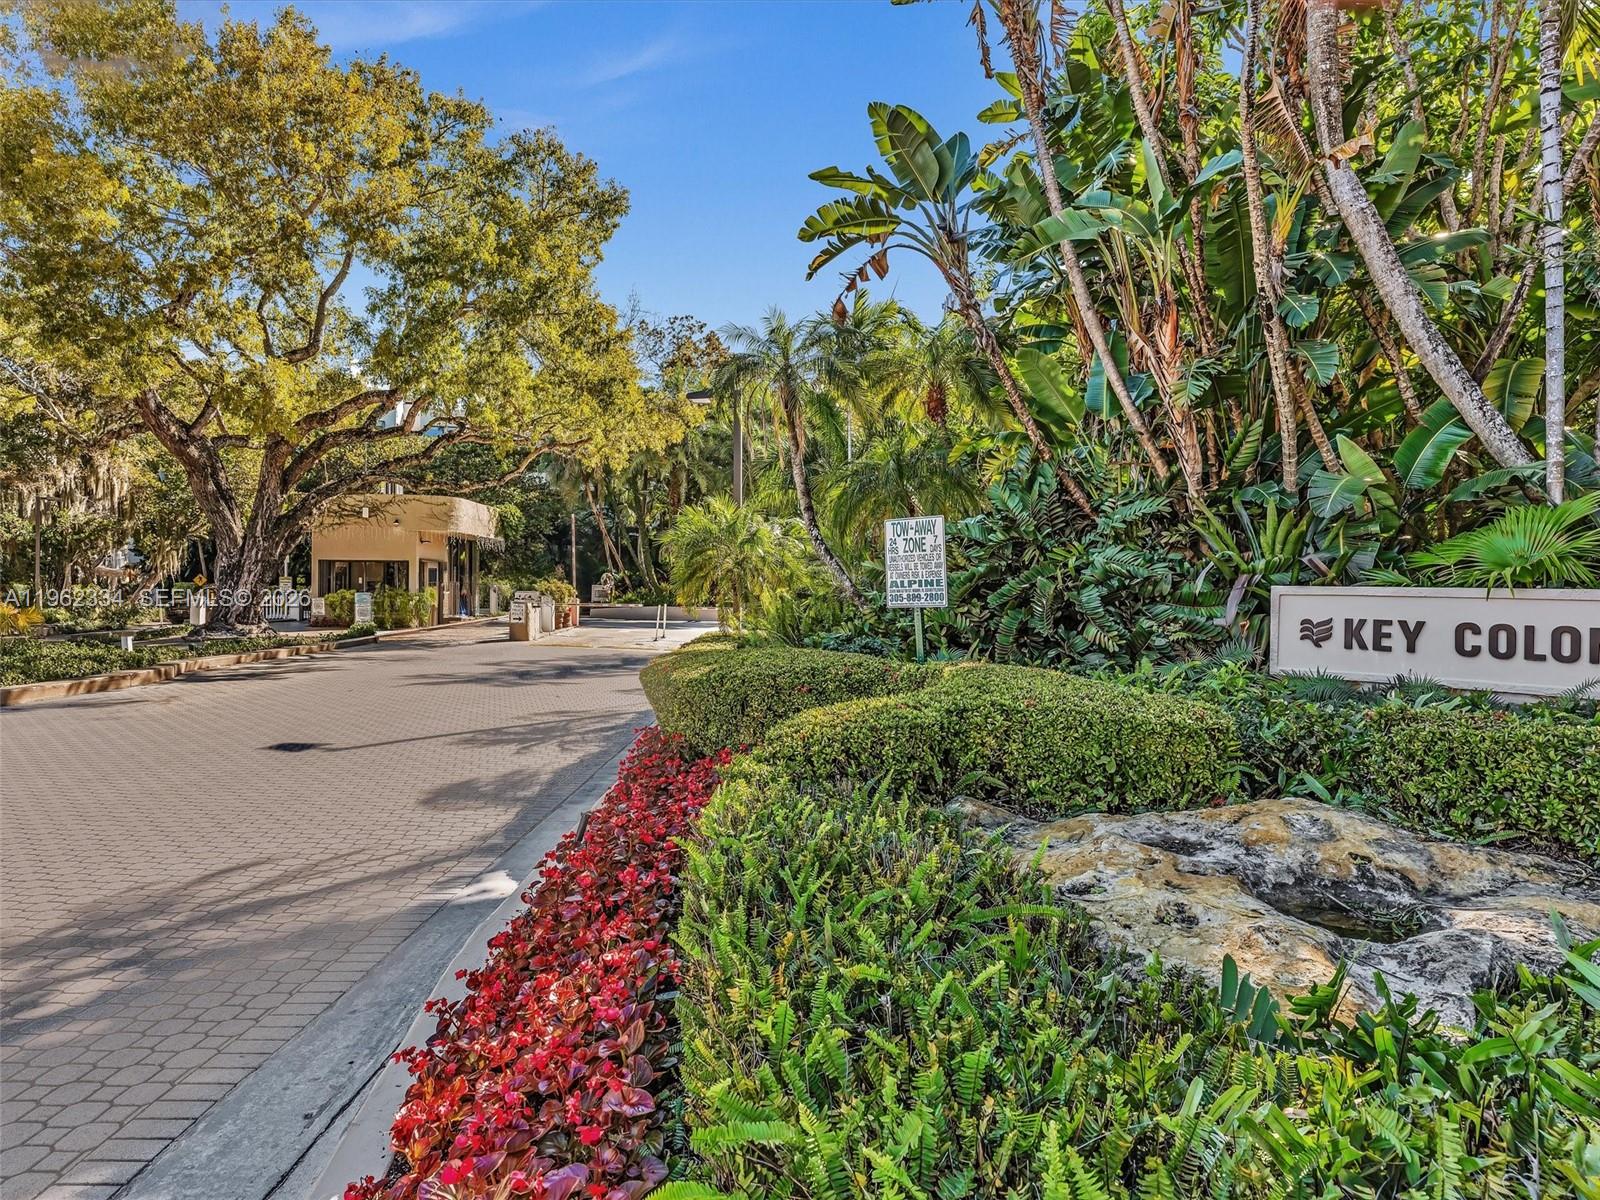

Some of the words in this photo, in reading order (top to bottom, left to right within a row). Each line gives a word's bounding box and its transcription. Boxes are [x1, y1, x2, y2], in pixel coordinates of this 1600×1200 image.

[891, 519, 937, 537] TOW-AWAY
[889, 538, 898, 547] 24
[933, 535, 938, 543] 7
[903, 537, 927, 553] ZONE
[930, 544, 942, 553] DAYS
[888, 546, 899, 555] HRS
[889, 554, 916, 563] UNAUTHORIZED
[916, 553, 935, 562] VEHICLES
[936, 553, 942, 561] OR
[904, 563, 913, 571] WILL
[914, 562, 919, 570] BE
[919, 562, 933, 570] TOWED
[911, 571, 920, 579] RISK
[925, 570, 942, 578] EXPENSE
[890, 579, 943, 588] ALPINE
[1344, 618, 1426, 653] KEY
